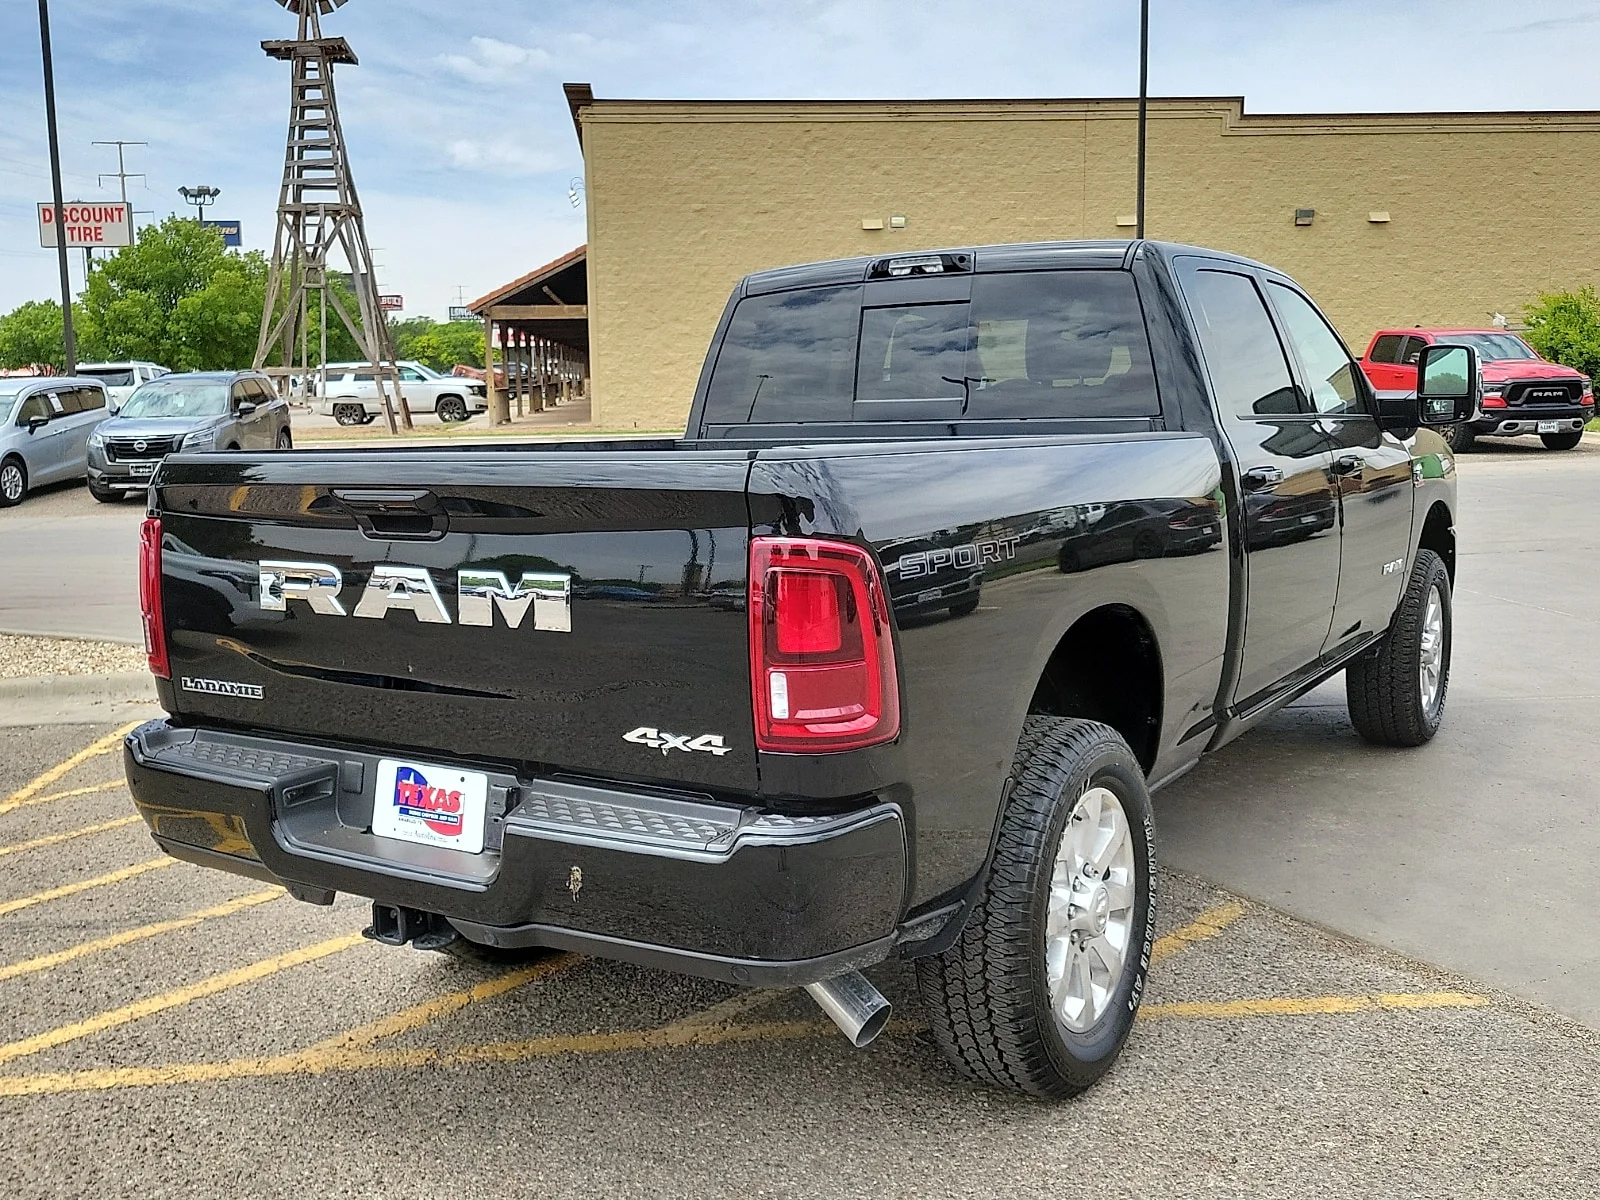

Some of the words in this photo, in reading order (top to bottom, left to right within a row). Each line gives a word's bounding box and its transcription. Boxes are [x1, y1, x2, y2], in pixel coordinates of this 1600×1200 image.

[42, 207, 124, 224] DSCOUNT
[67, 226, 103, 242] TIRE
[899, 536, 1020, 580] SPORT
[259, 560, 572, 632] RAM
[181, 676, 265, 700] LARAMIE
[398, 781, 461, 813] TEXAS
